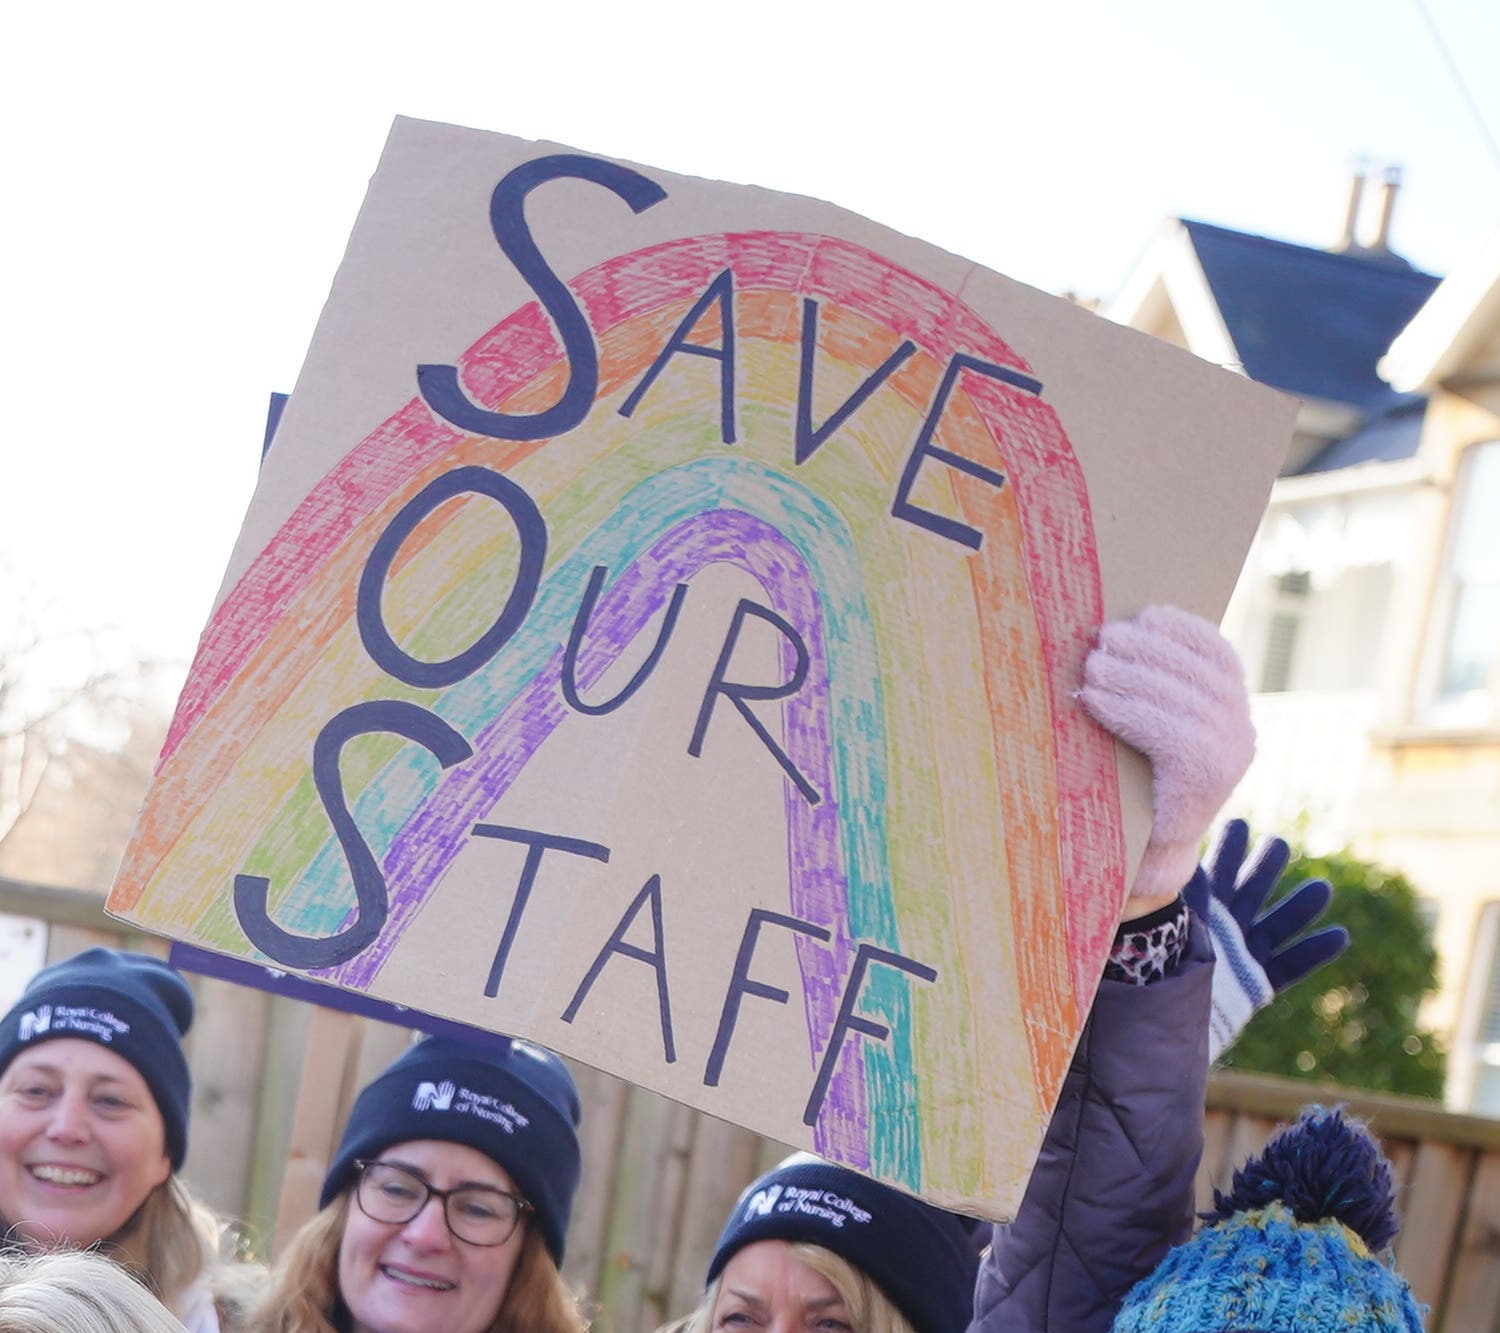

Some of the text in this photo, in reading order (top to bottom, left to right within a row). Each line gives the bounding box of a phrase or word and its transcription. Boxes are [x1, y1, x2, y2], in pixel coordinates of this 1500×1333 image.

[415, 153, 1042, 551] SAVE
[356, 464, 821, 805] OUR
[234, 698, 937, 1127] STAFF
[69, 1018, 113, 1041] Nursing
[472, 1104, 514, 1134] Nursing
[784, 1187, 873, 1224] Royal College
[795, 1201, 847, 1227] Nursing
